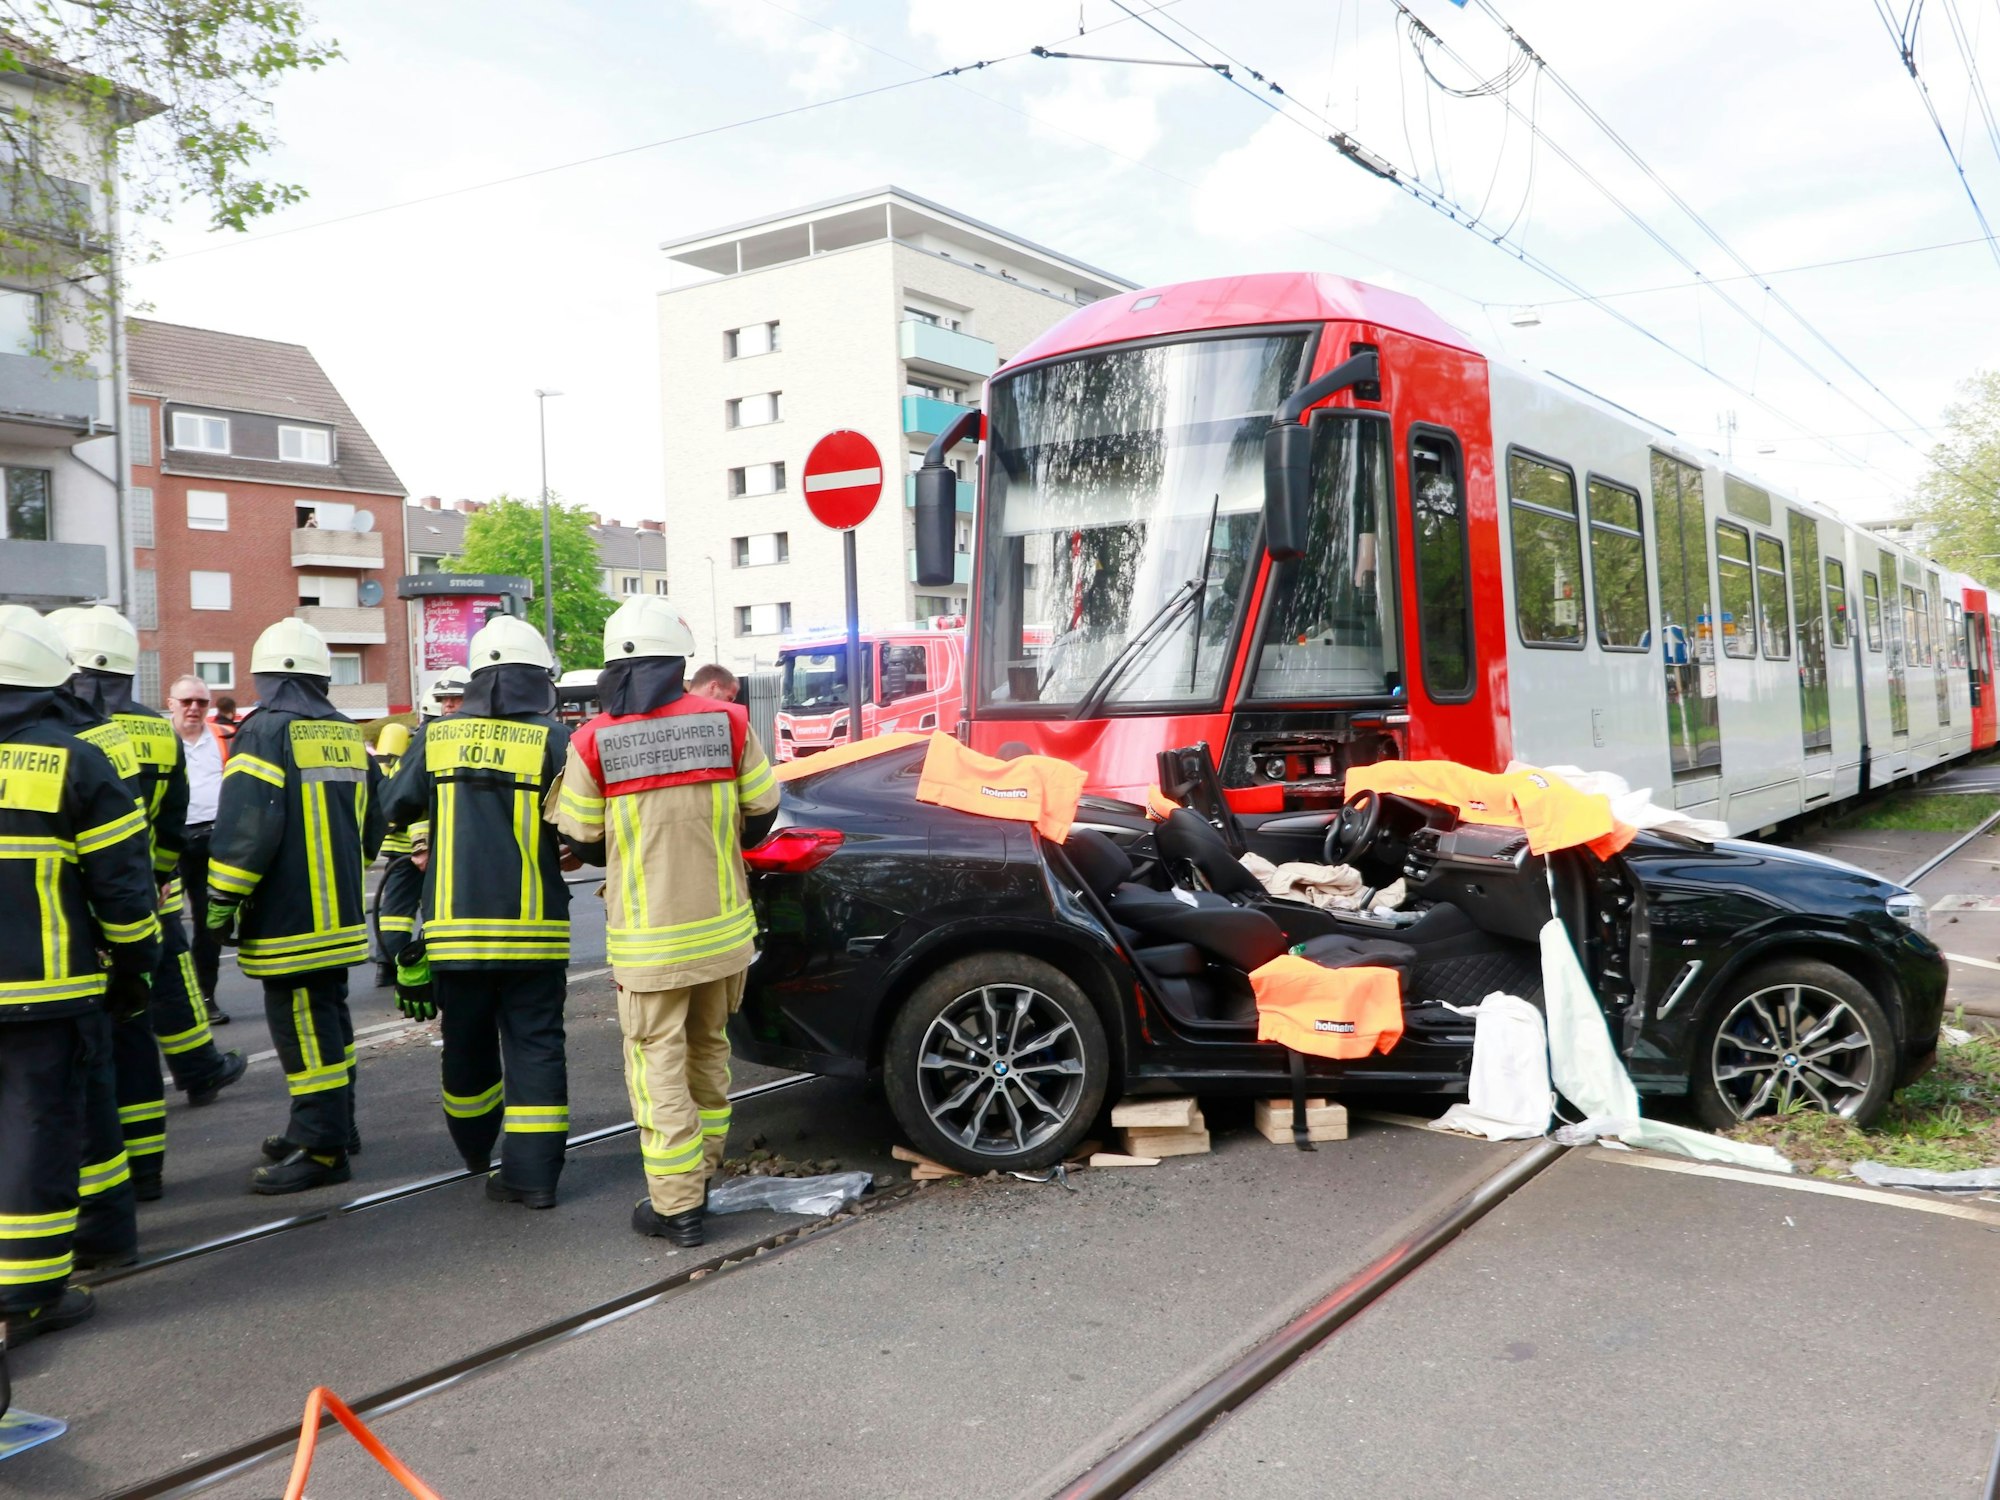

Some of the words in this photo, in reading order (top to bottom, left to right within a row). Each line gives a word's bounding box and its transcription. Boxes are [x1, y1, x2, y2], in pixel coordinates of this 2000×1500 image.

[603, 725, 715, 753] RÜSTZUGFÜHRER
[717, 725, 725, 737] 5
[459, 741, 506, 766] KÖLN
[604, 743, 730, 773] BERUFSFEUERWEHR
[982, 786, 1027, 797] holmatro
[1315, 1020, 1355, 1033] holmatro
